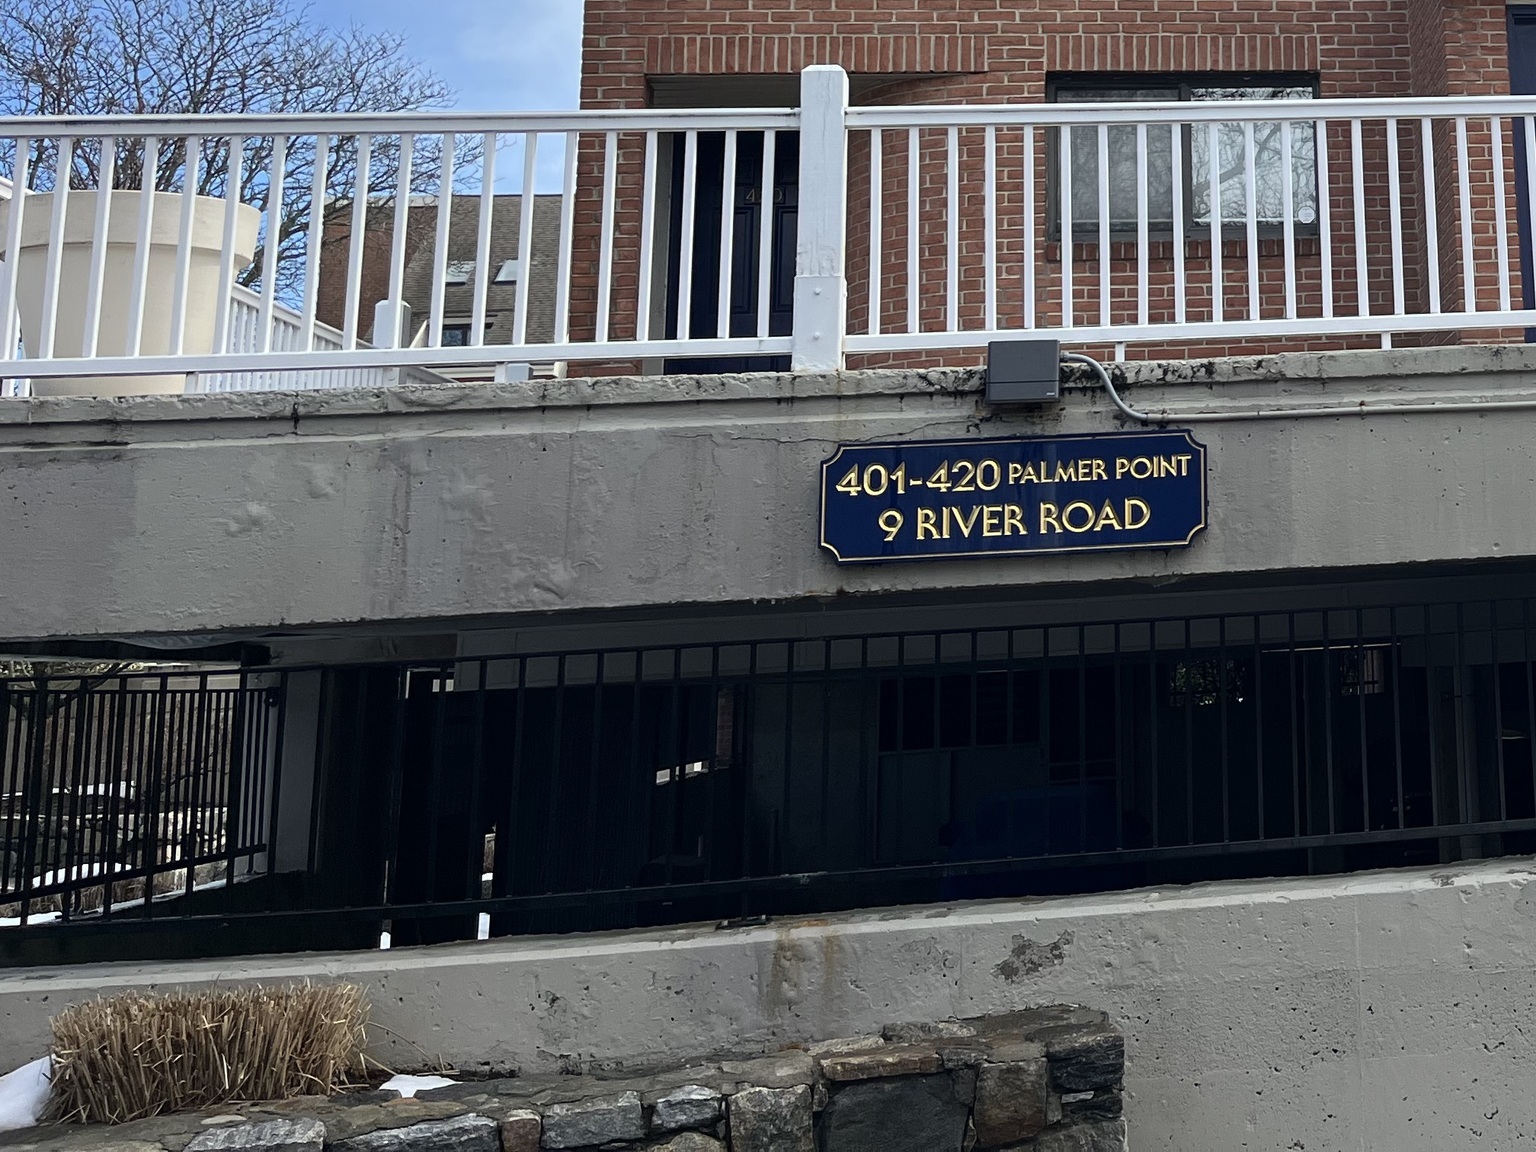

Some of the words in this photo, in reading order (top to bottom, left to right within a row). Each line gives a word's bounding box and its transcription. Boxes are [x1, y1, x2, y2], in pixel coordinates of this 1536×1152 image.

[745, 188, 783, 203] 40
[835, 458, 1001, 497] 401-420
[1008, 457, 1109, 485] PALMER
[1115, 454, 1192, 480] POINT
[878, 508, 904, 542] 9
[916, 503, 1028, 540] RIVER
[1040, 496, 1152, 534] ROAD
